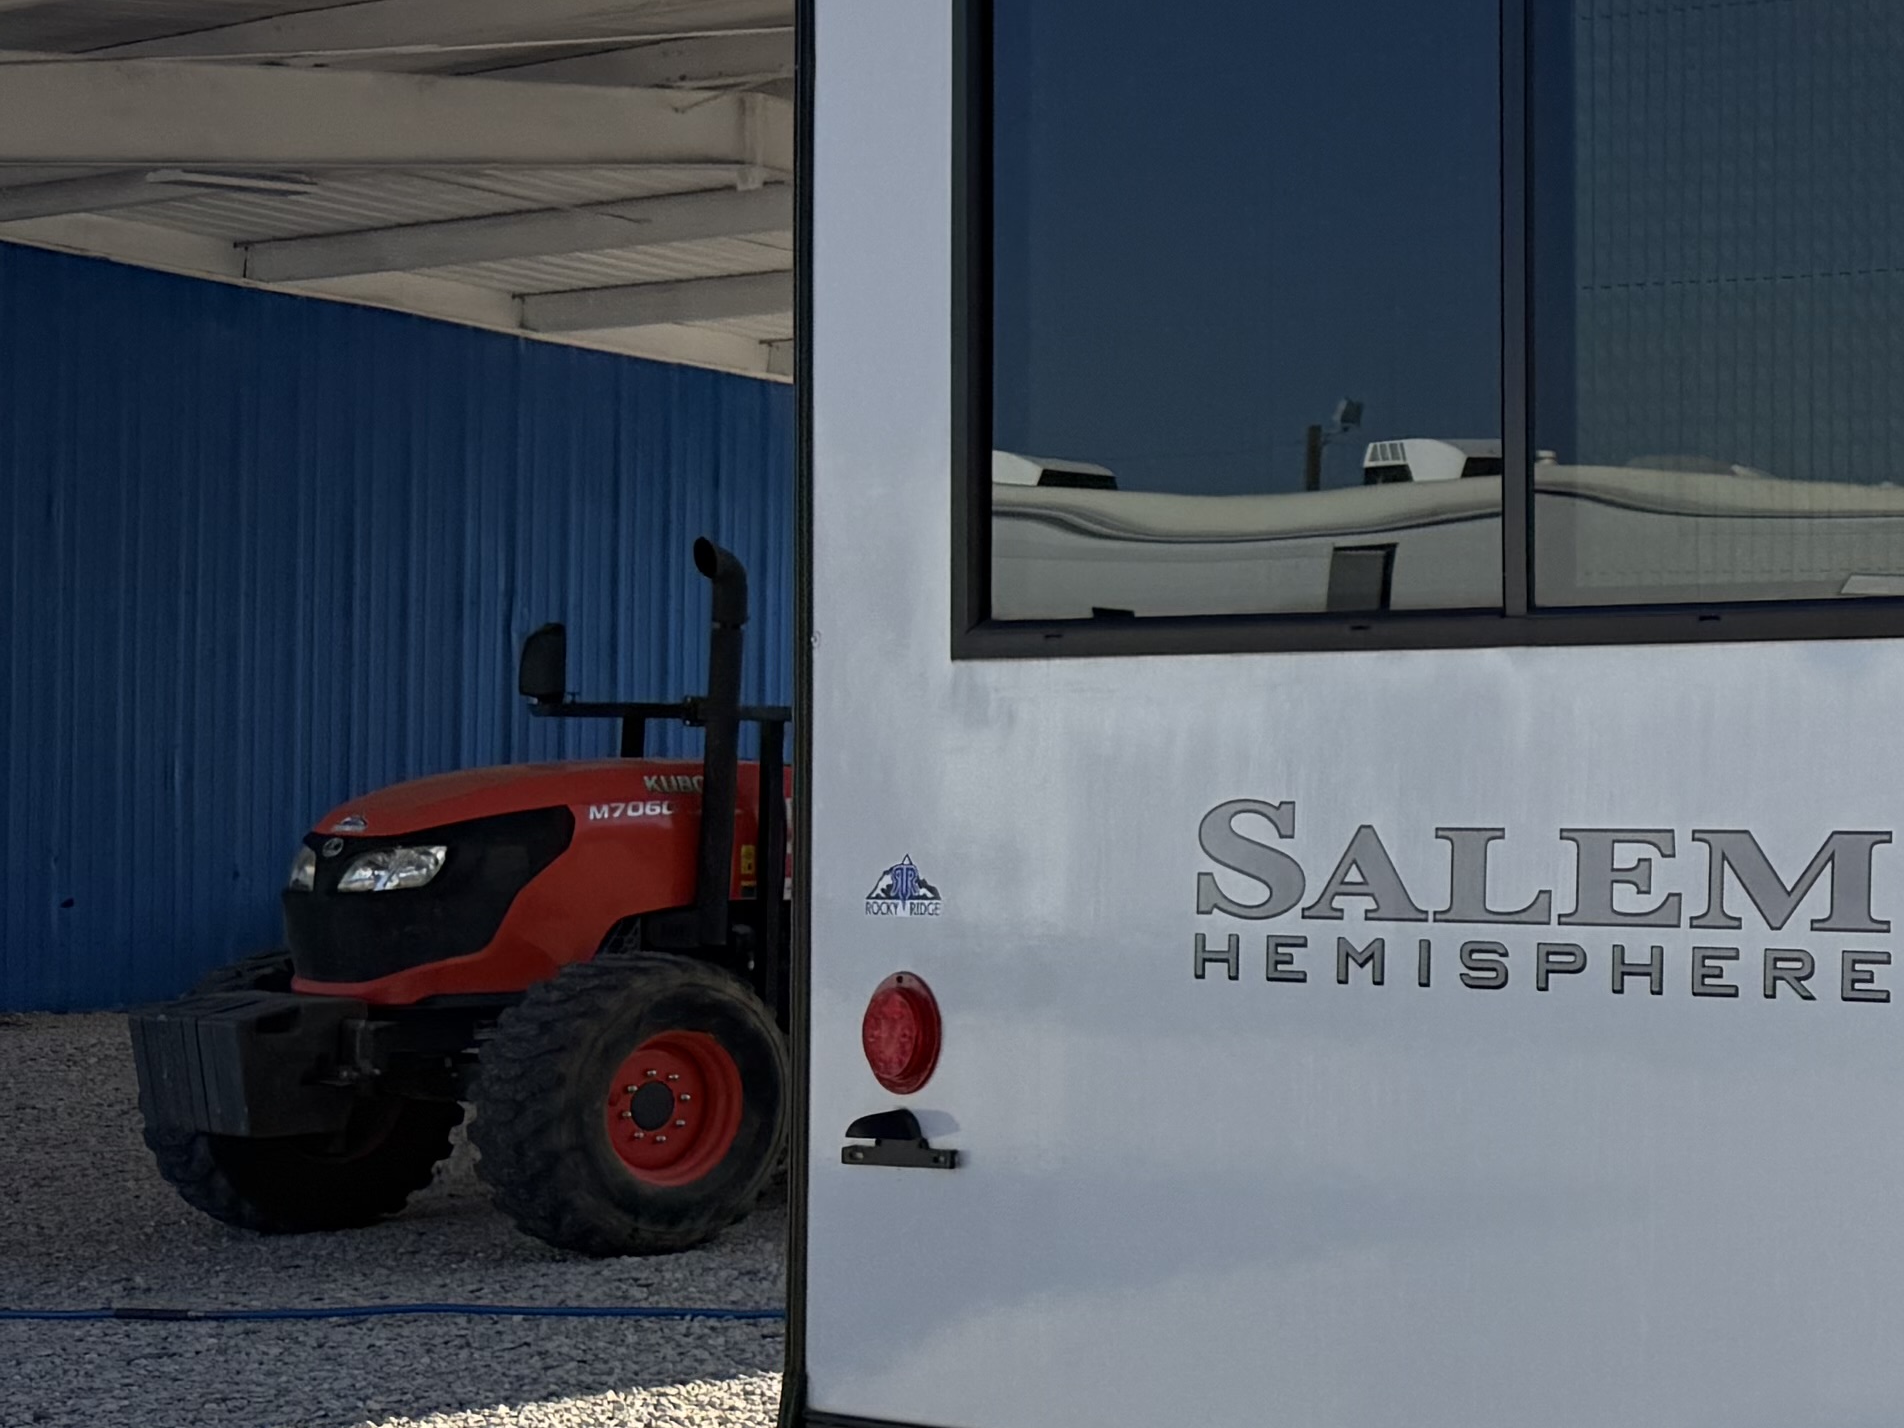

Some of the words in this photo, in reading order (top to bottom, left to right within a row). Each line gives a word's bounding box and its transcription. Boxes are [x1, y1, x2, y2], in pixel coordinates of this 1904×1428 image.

[643, 775, 705, 794] KUBO
[1196, 797, 1893, 932] SALEM
[865, 901, 899, 916] ROCKY
[909, 902, 942, 916] RIDGE
[1193, 932, 1893, 1003] HEMISPHERE
